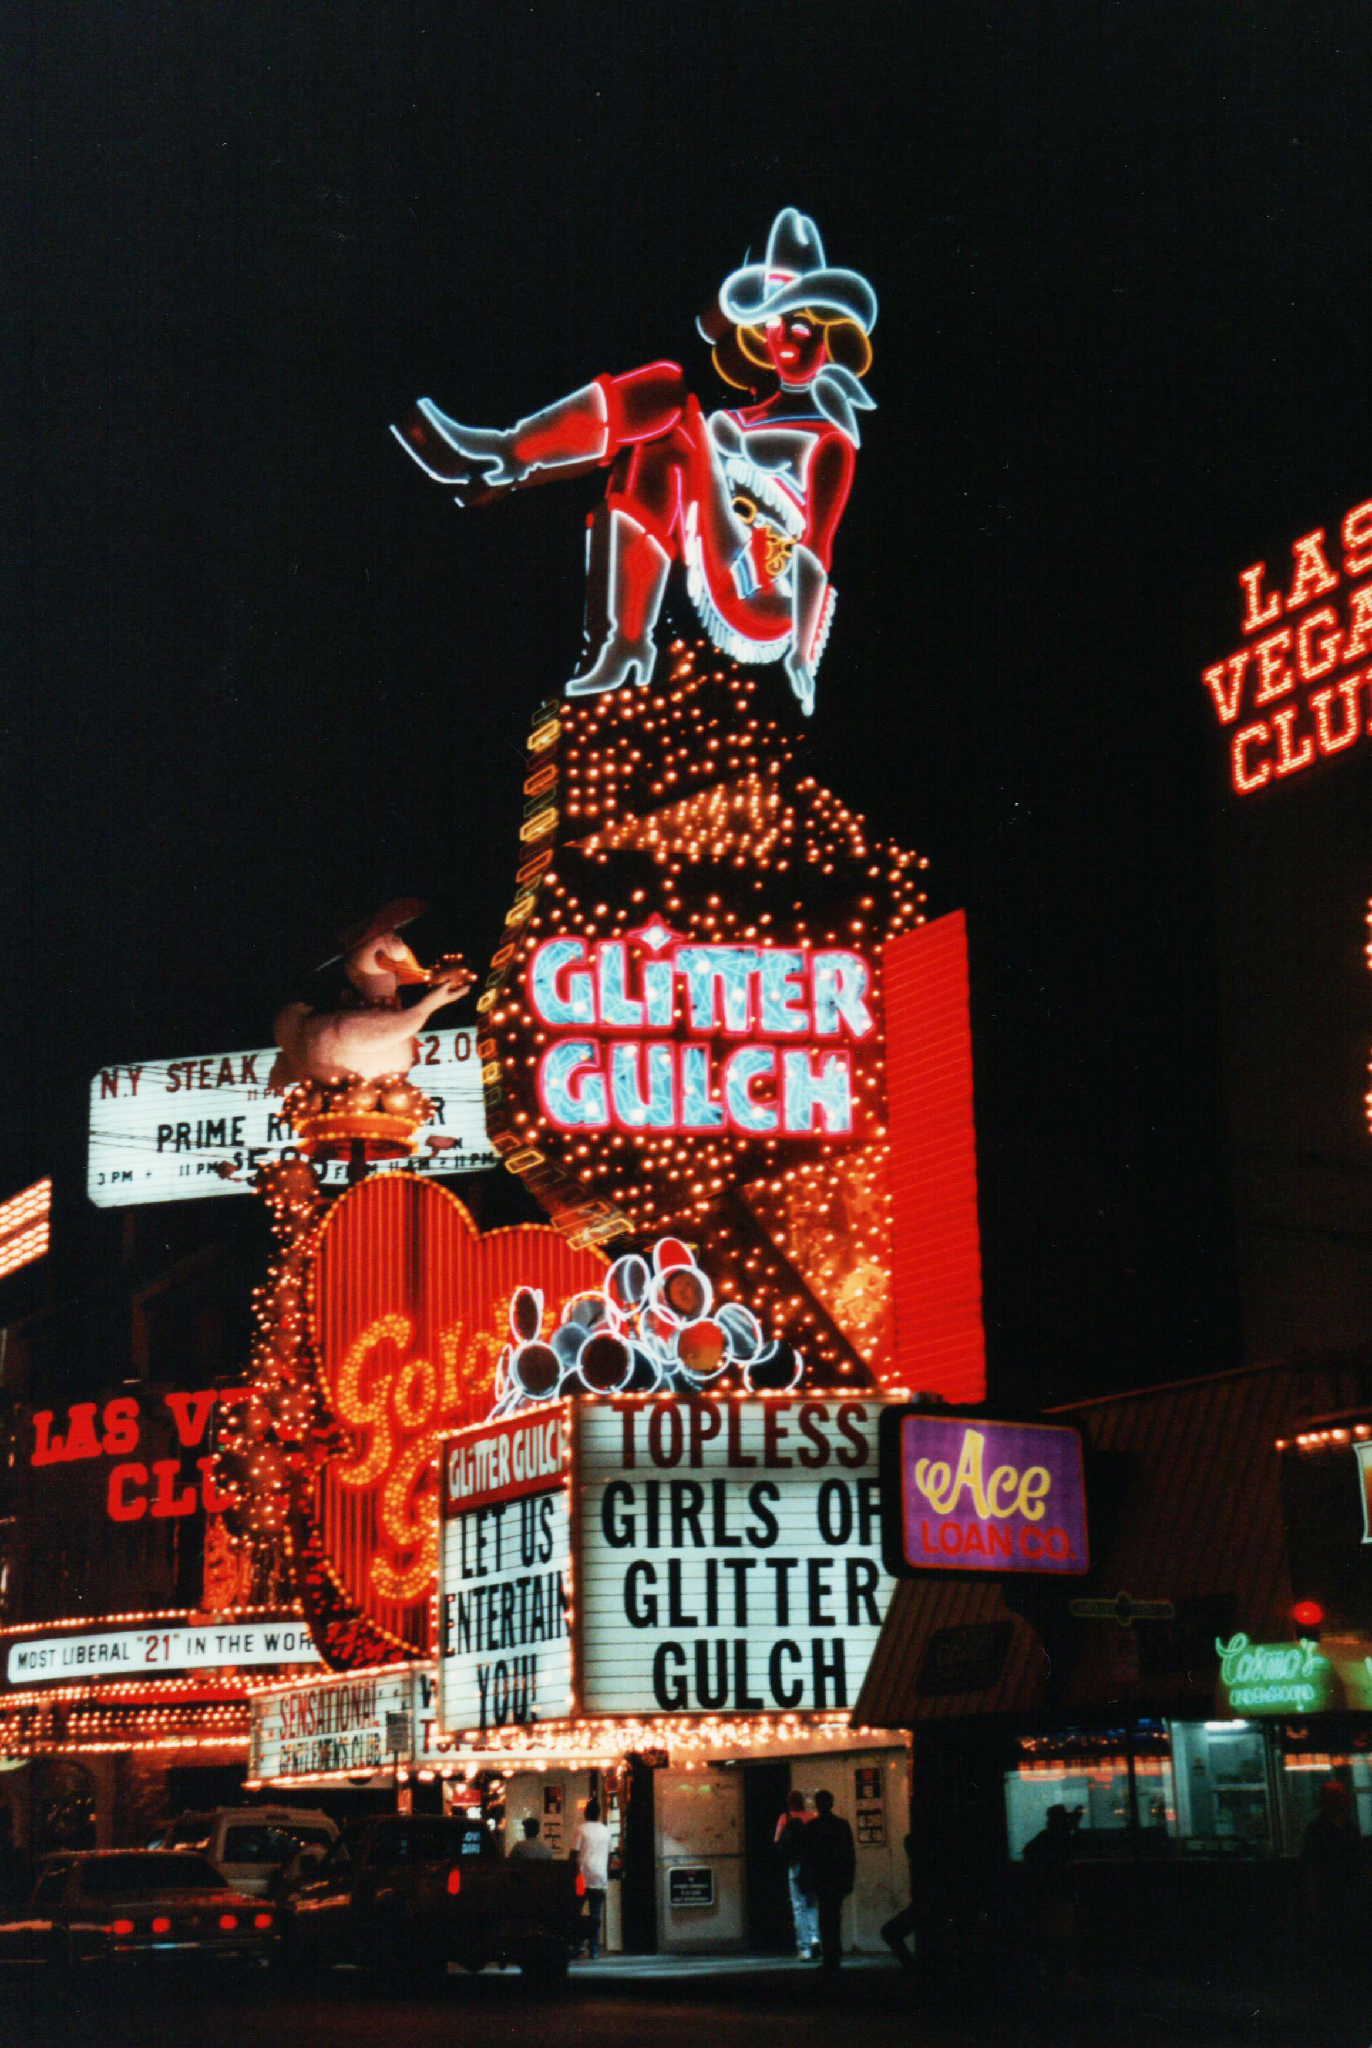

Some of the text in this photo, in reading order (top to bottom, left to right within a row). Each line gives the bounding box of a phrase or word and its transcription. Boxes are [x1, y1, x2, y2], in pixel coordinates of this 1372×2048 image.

[1240, 499, 1372, 634] LAS
[1232, 669, 1372, 793] CLU
[165, 1054, 258, 1092] STEAK
[536, 1039, 853, 1137] GULCH
[157, 1116, 246, 1153] PRIME
[112, 1171, 133, 1184] PM
[31, 1397, 139, 1466] LAS
[613, 1400, 869, 1469] TOPLESS
[107, 1457, 244, 1522] CLU
[602, 1478, 779, 1548] GIRLS
[462, 1500, 506, 1580] LET
[521, 1496, 554, 1569] US
[921, 1520, 1077, 1561] LOAN CO.
[624, 1557, 881, 1629] GLITTER
[17, 1648, 55, 1671] MOST
[63, 1642, 130, 1666] LIBERAL
[187, 1636, 206, 1656] IN
[216, 1634, 253, 1653] THE
[264, 1633, 312, 1652] WOR
[653, 1638, 848, 1710] GULCH
